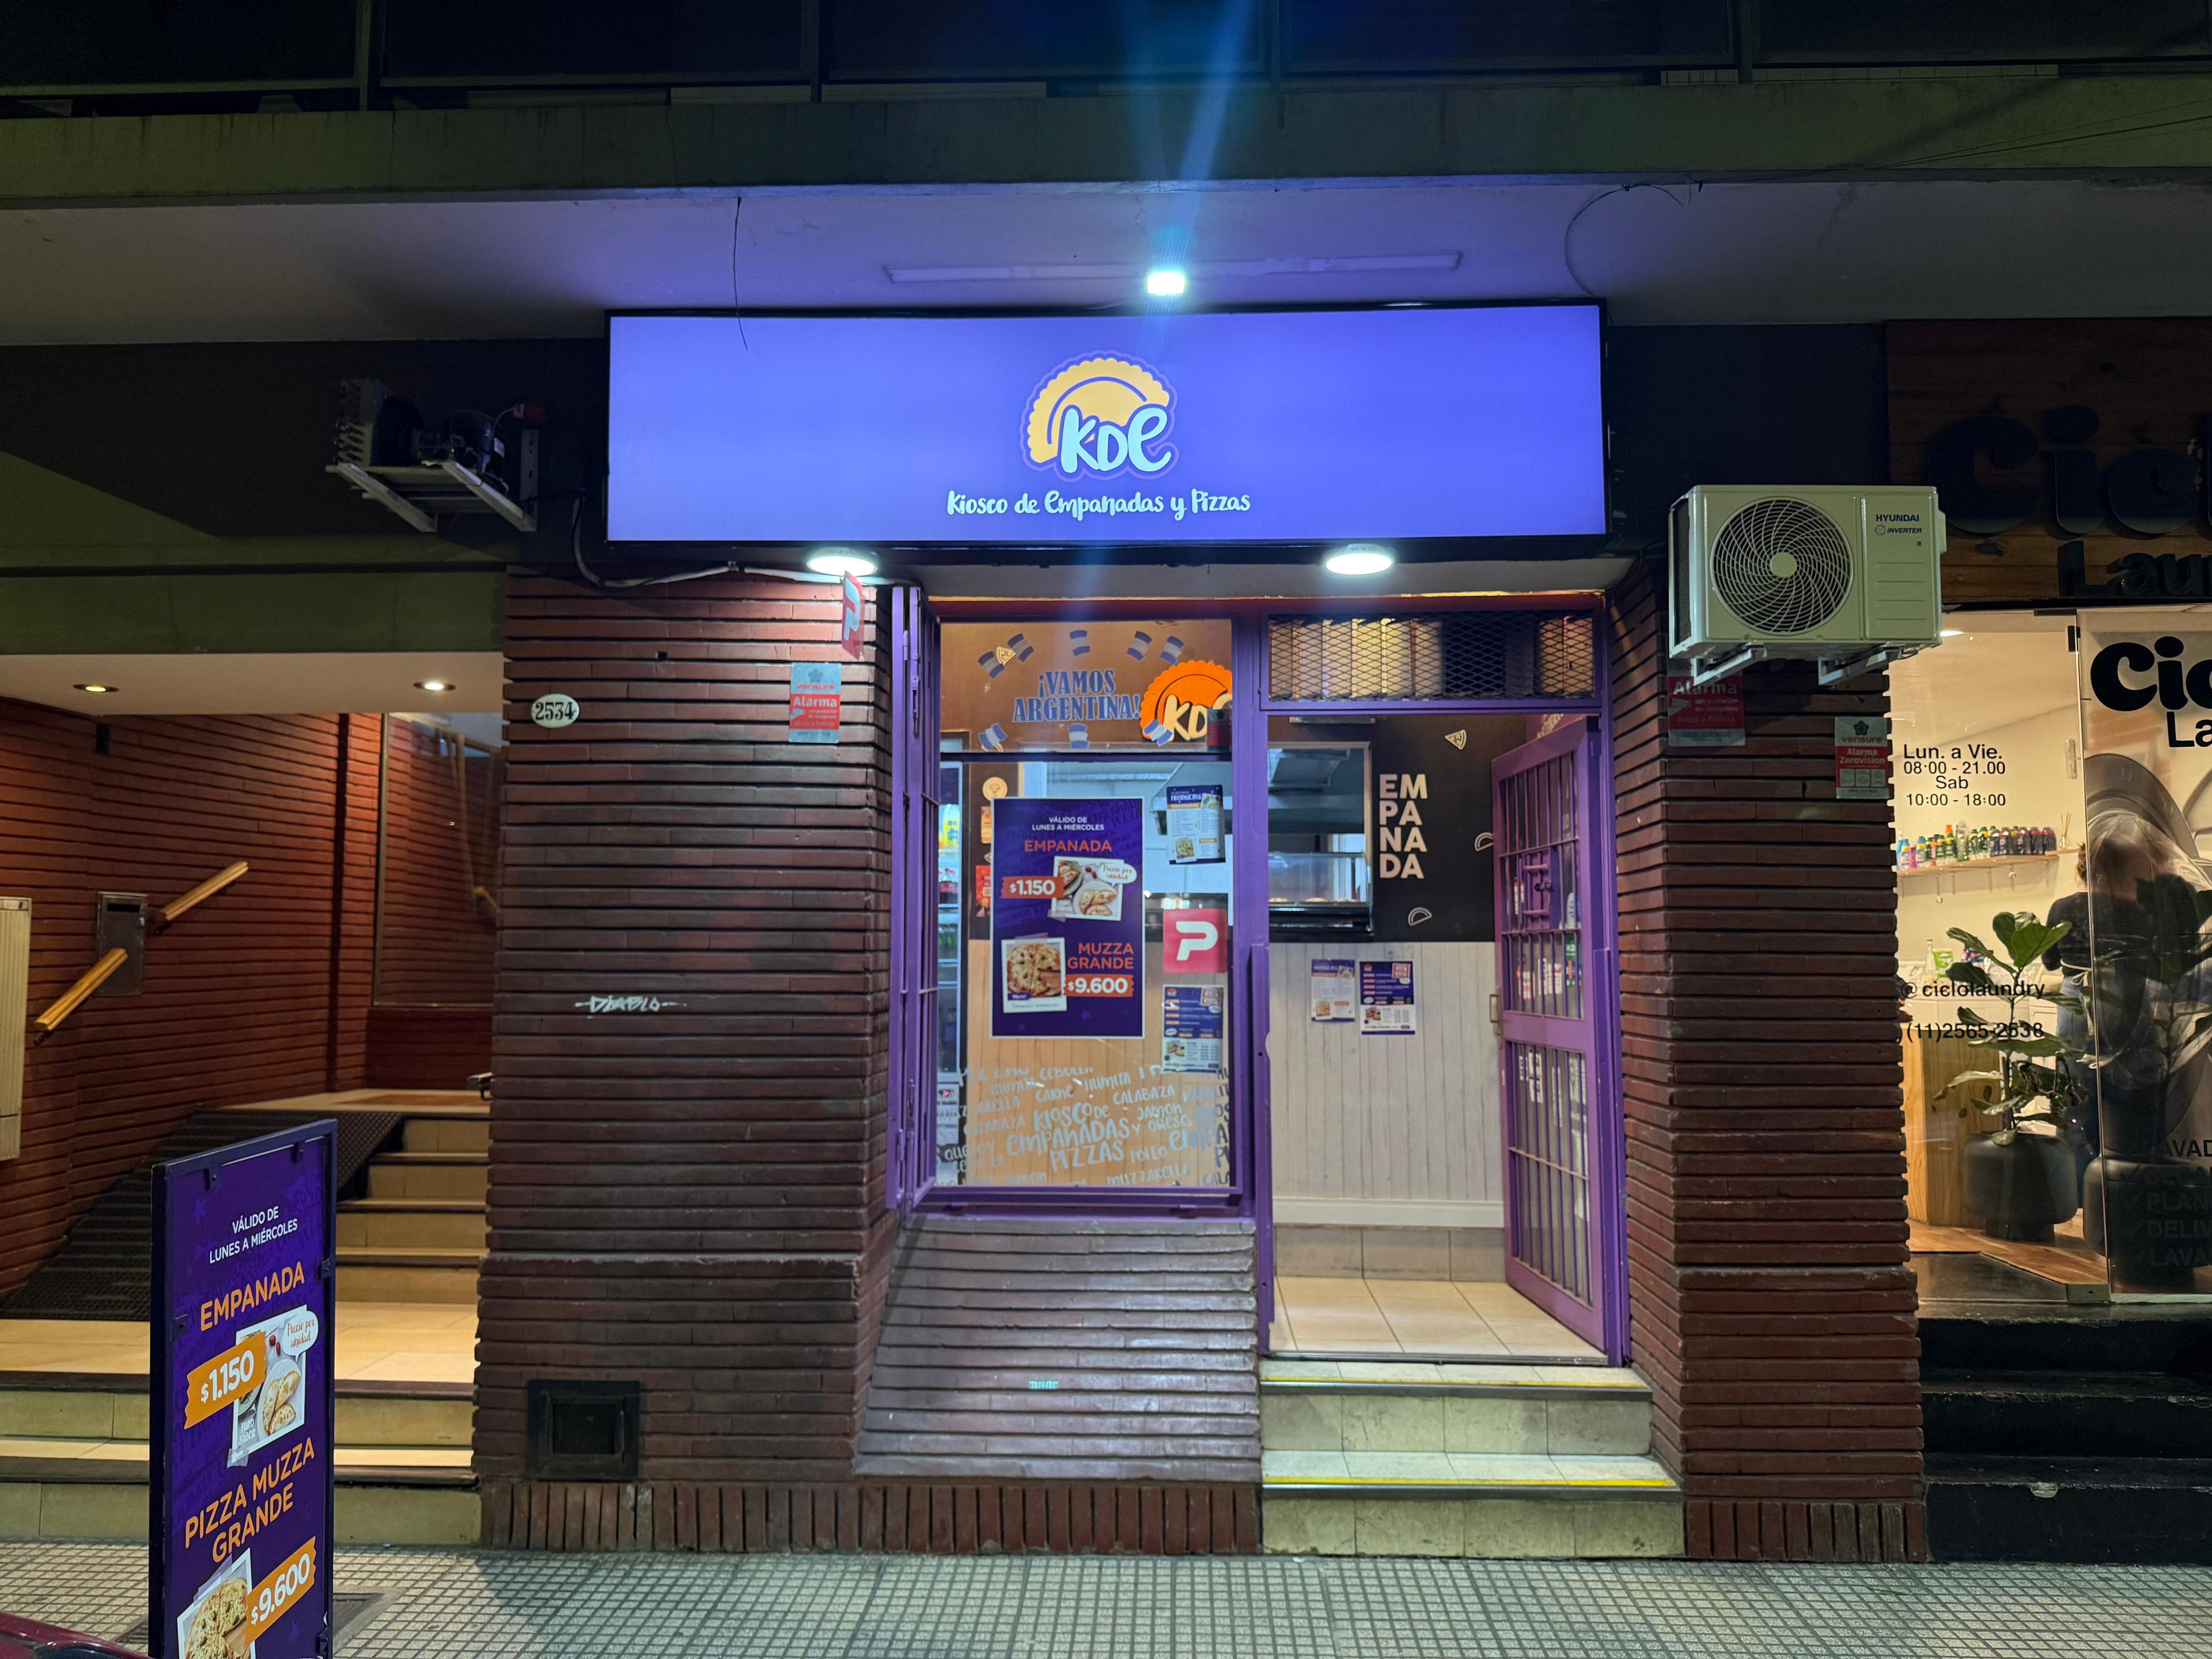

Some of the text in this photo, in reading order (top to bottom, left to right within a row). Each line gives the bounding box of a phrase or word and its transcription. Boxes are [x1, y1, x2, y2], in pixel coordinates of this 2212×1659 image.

[947, 490, 1007, 514] Kiosco
[1014, 493, 1040, 514] de
[1171, 496, 1187, 521] y
[1191, 488, 1251, 514] Pizzas
[1038, 669, 1116, 698] ¡VAMOS
[536, 702, 577, 721] 2534
[793, 696, 838, 707] Alarma
[1013, 695, 1141, 722] ARGENTINA!
[1162, 694, 1233, 742] KD
[1847, 748, 1878, 756] Alarma
[1904, 744, 2002, 759] Lun. a Vie.
[1379, 774, 1428, 800] EM
[1936, 775, 1969, 789] Sab
[1906, 793, 1948, 806] 10:00
[1964, 793, 2006, 806] 18:00
[1049, 815, 1075, 823] VÁLIDO
[1379, 801, 1423, 825] PA
[1064, 823, 1105, 831] MIÉRCOLES
[1024, 840, 1112, 853] EMPANADA
[1379, 827, 1428, 853] NA
[1379, 854, 1425, 879] DA
[1009, 878, 1056, 896] $1.150
[1078, 942, 1134, 955] MUZZA
[1067, 957, 1134, 970] GRANDE
[1067, 977, 1128, 994] $9.600
[1922, 979, 2046, 999] ciclolaundry
[1112, 1084, 1175, 1105] CALABAZA
[1033, 1101, 1094, 1132] KIOSCO
[1050, 1141, 1124, 1172] PIZZAS
[232, 1206, 279, 1234] VÁLIDO DE
[210, 1218, 298, 1264] LUNES A MIÉRCOLES
[200, 1262, 305, 1332] EMPANADA
[291, 1332, 311, 1348] unidad
[200, 1350, 255, 1404] $1.150
[185, 1437, 315, 1549] PIZZA MUZZA
[212, 1482, 294, 1563] GRANDE
[251, 1553, 310, 1626] $9.600
